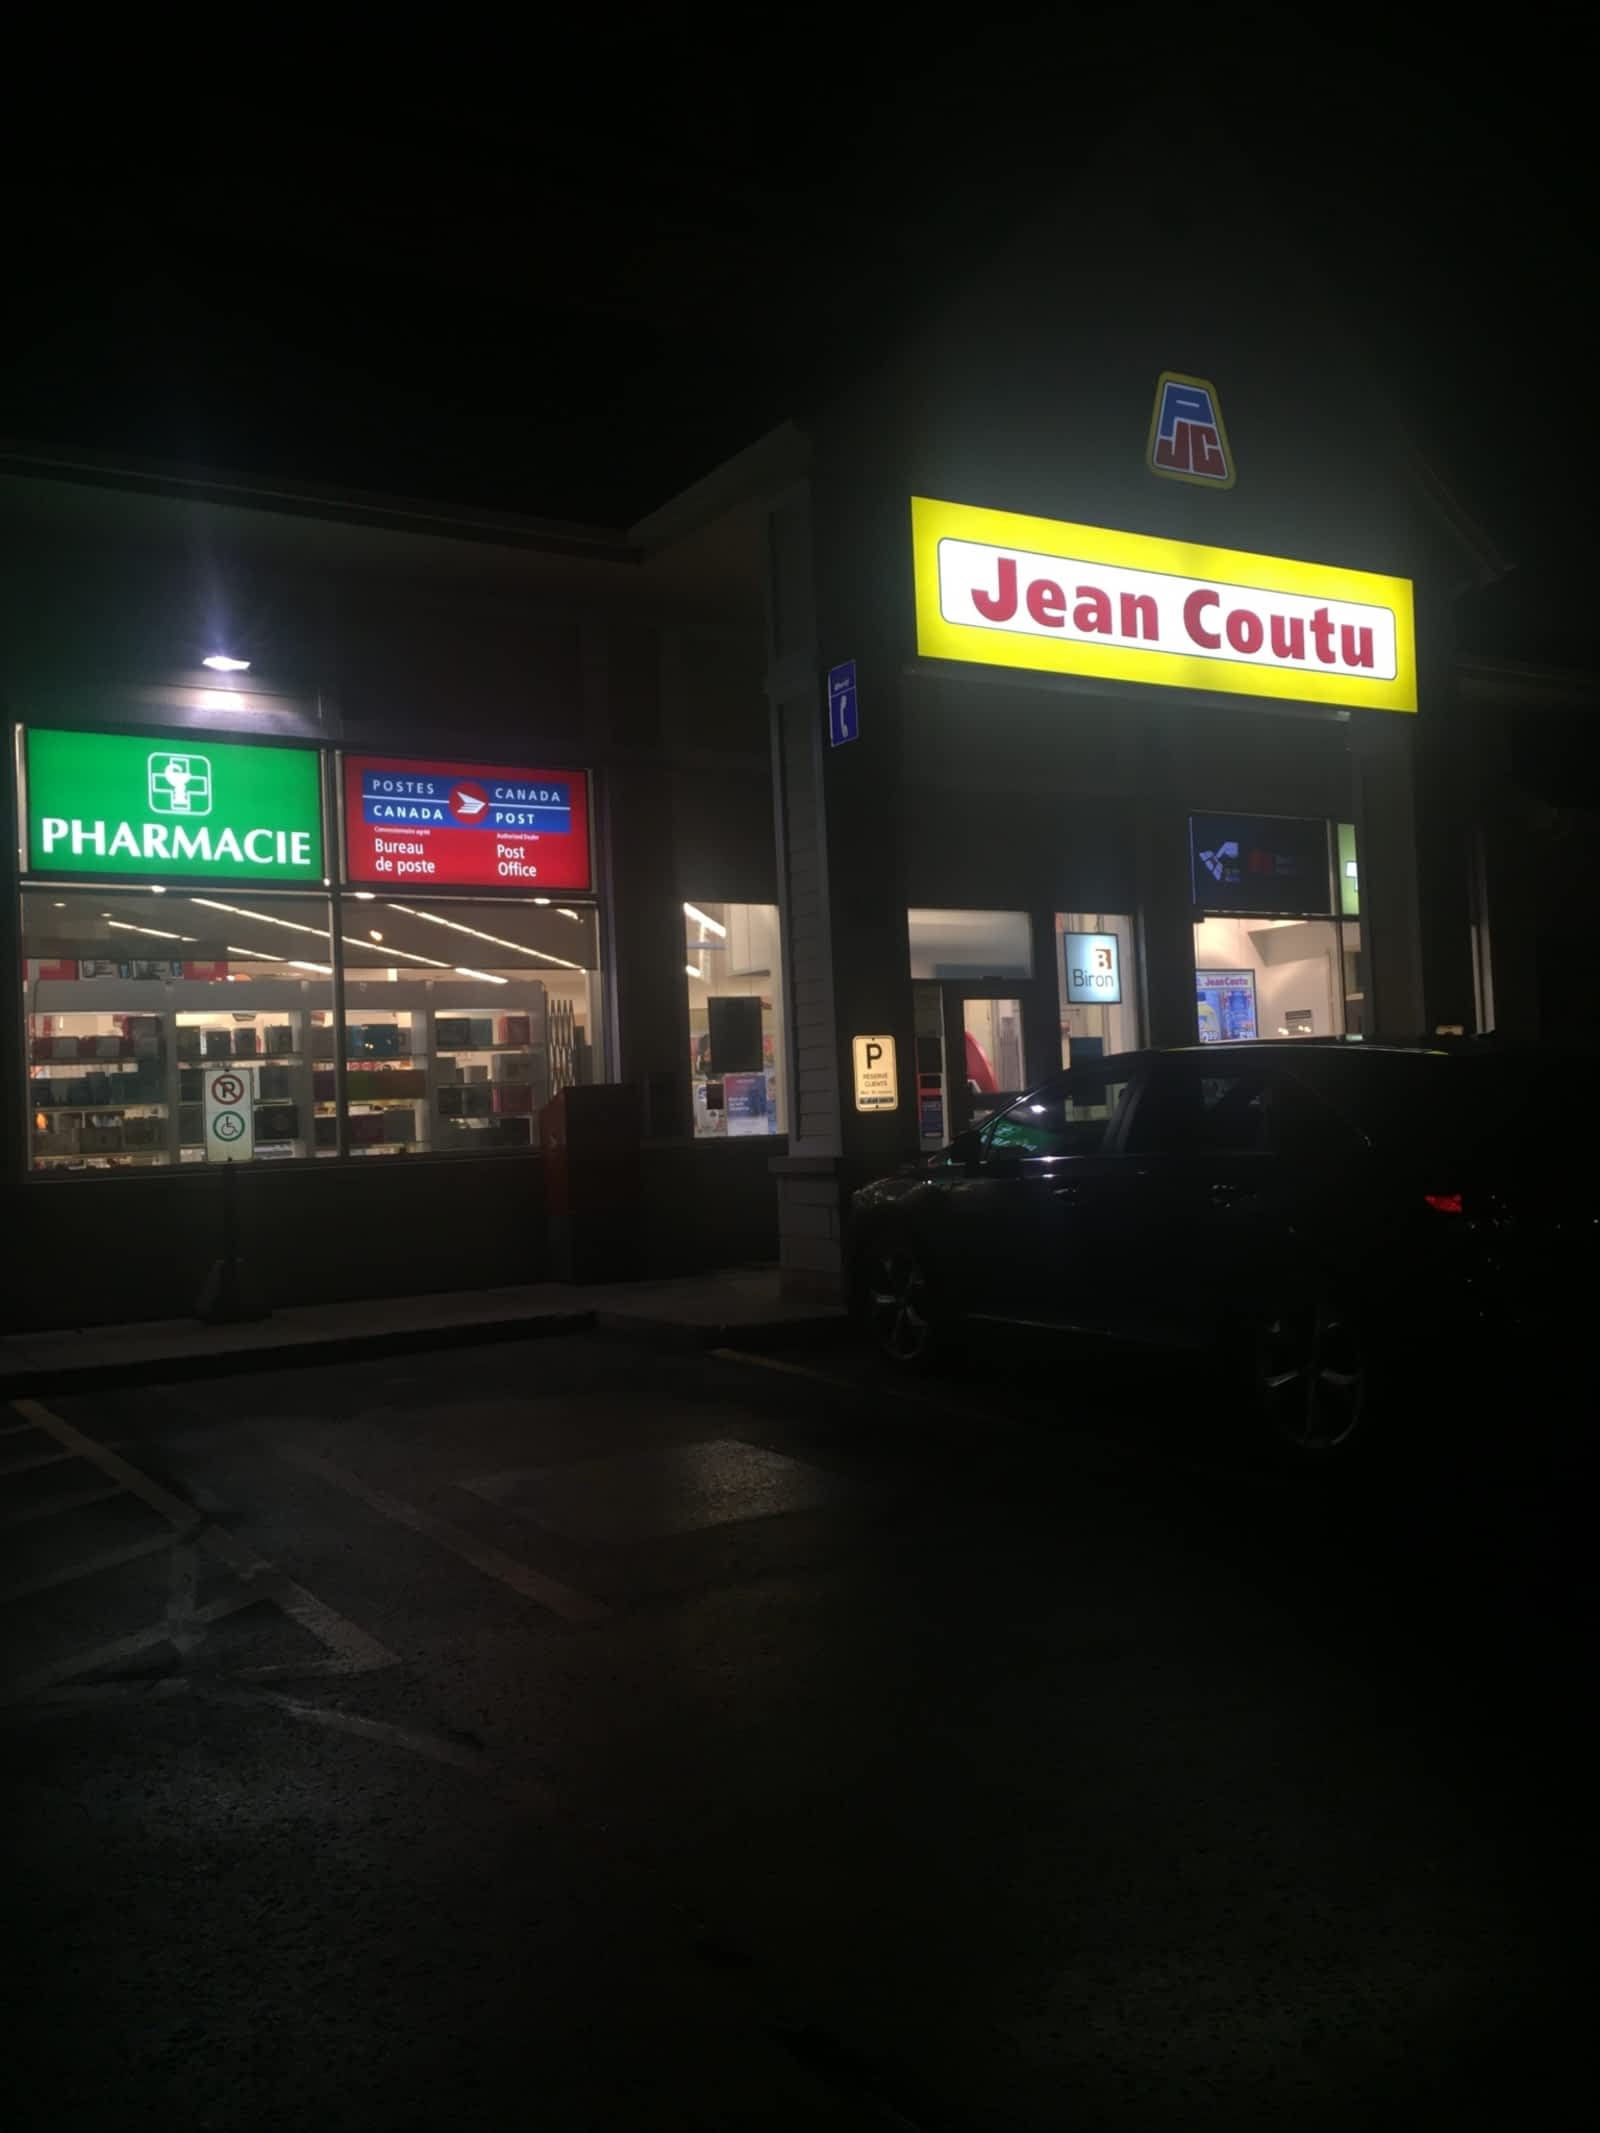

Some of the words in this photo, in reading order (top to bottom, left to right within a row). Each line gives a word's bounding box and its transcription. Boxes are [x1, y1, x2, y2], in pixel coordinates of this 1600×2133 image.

[970, 556, 1160, 642] Jean
[1183, 589, 1375, 669] Coutu
[372, 779, 435, 795] POSTES
[495, 788, 561, 802] CANADA
[373, 804, 444, 820] CANADA
[496, 812, 536, 825] POST
[41, 817, 311, 865] PHARMACIE
[375, 838, 424, 855] Bureau
[497, 844, 525, 859] Post
[375, 857, 393, 872] de
[397, 859, 436, 875] poste
[498, 862, 538, 877] Office
[1072, 968, 1114, 988] Biron
[866, 1043, 883, 1069] P
